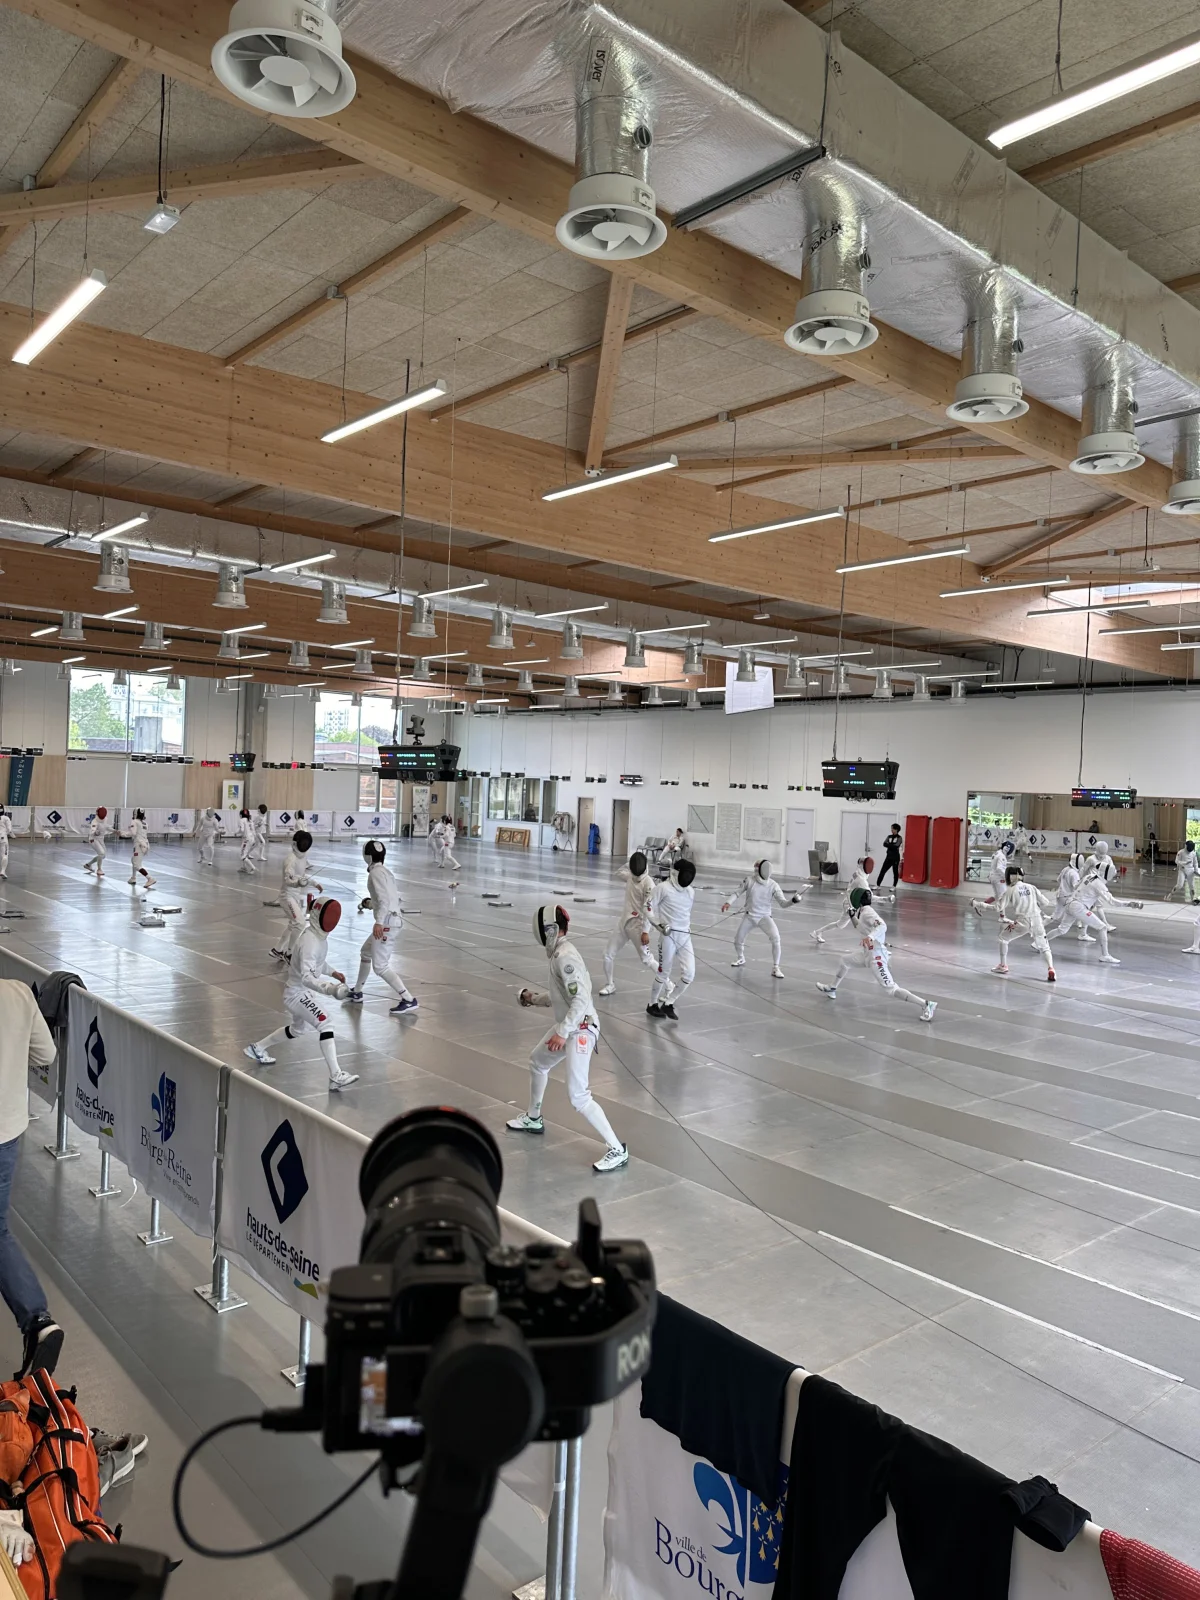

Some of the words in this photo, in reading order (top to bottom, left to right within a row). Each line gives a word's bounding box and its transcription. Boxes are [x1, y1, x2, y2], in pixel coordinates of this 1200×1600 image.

[876, 792, 886, 800] 06
[300, 993, 323, 1019] JAPAN
[246, 1206, 320, 1282] hauts-de-seine
[246, 1230, 253, 1244] LE
[253, 1238, 293, 1277] DÉPARTEMENT
[675, 1536, 696, 1553] ville
[696, 1547, 707, 1563] de
